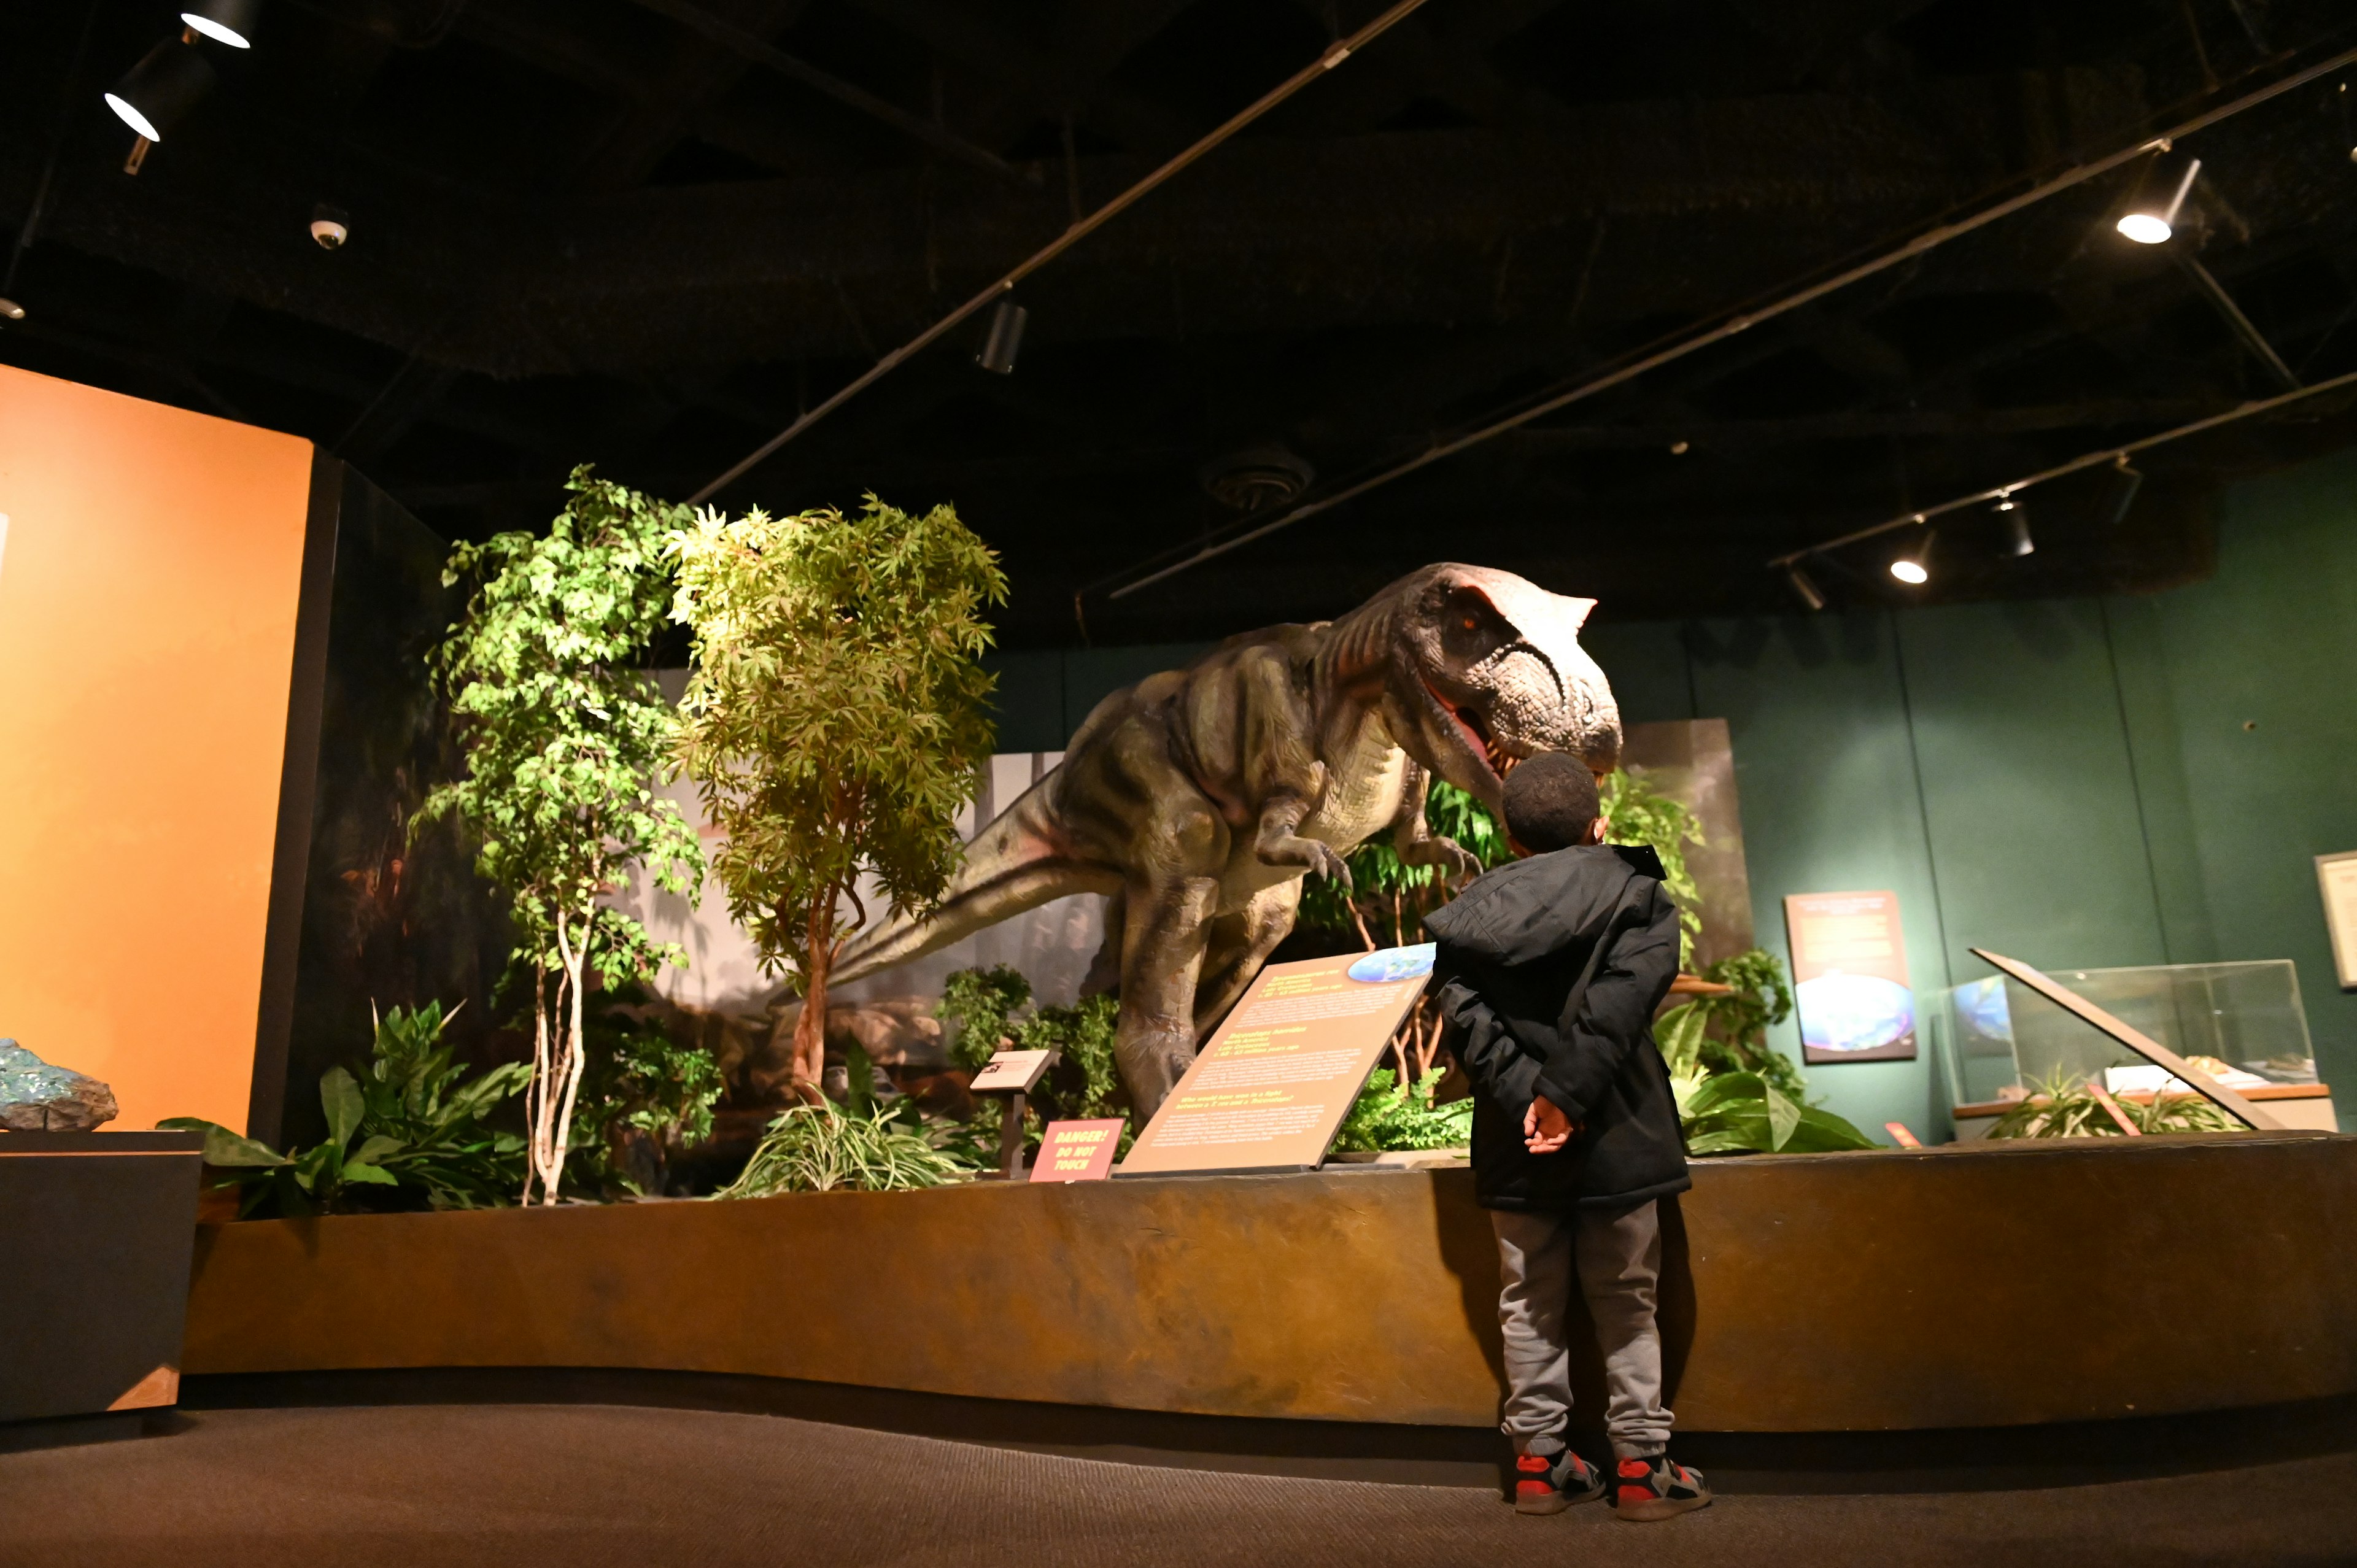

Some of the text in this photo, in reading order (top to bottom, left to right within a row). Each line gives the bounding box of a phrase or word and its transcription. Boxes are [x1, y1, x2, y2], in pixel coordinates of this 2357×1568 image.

[1054, 1129, 1109, 1143] DANGER!
[1055, 1146, 1097, 1158] DO NOT
[1054, 1159, 1090, 1171] TOUCH
